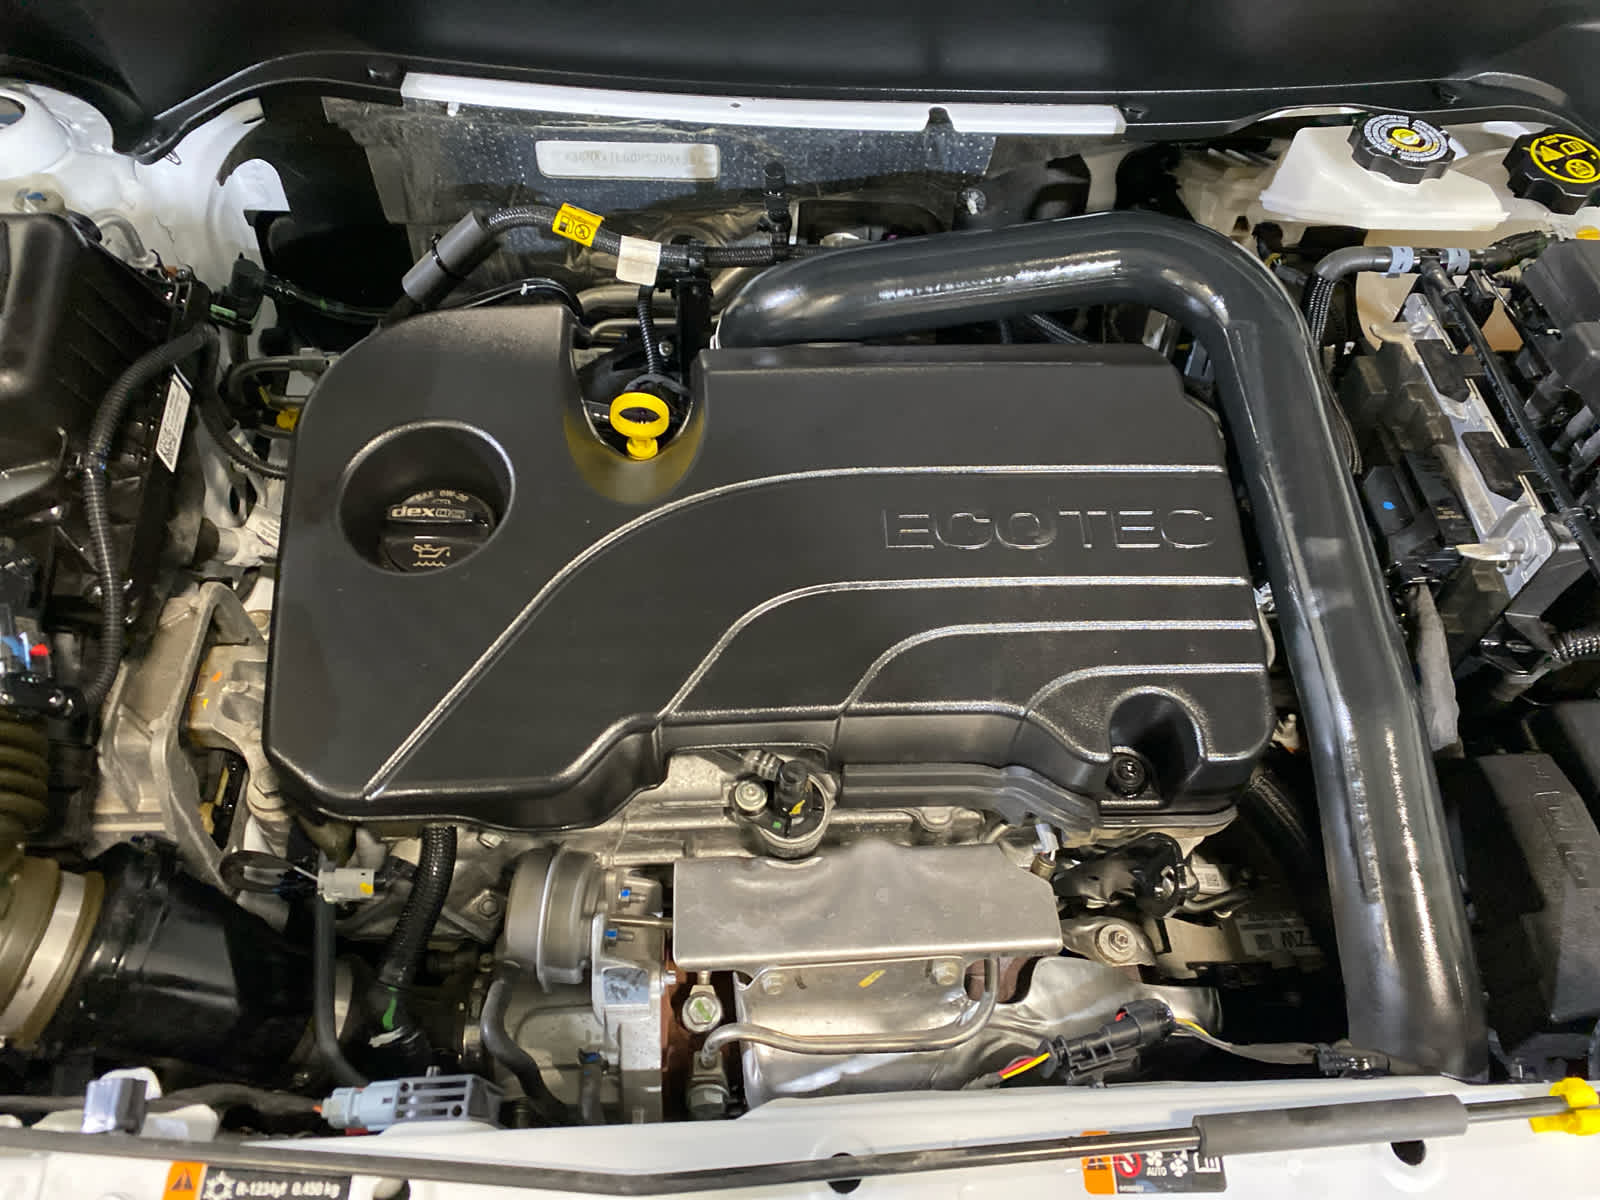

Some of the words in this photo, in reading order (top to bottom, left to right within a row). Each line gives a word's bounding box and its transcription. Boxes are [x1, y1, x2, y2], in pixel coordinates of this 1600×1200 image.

[391, 505, 467, 519] dexos
[881, 508, 1215, 551] ECOTEC
[1146, 1166, 1168, 1177] AUTO
